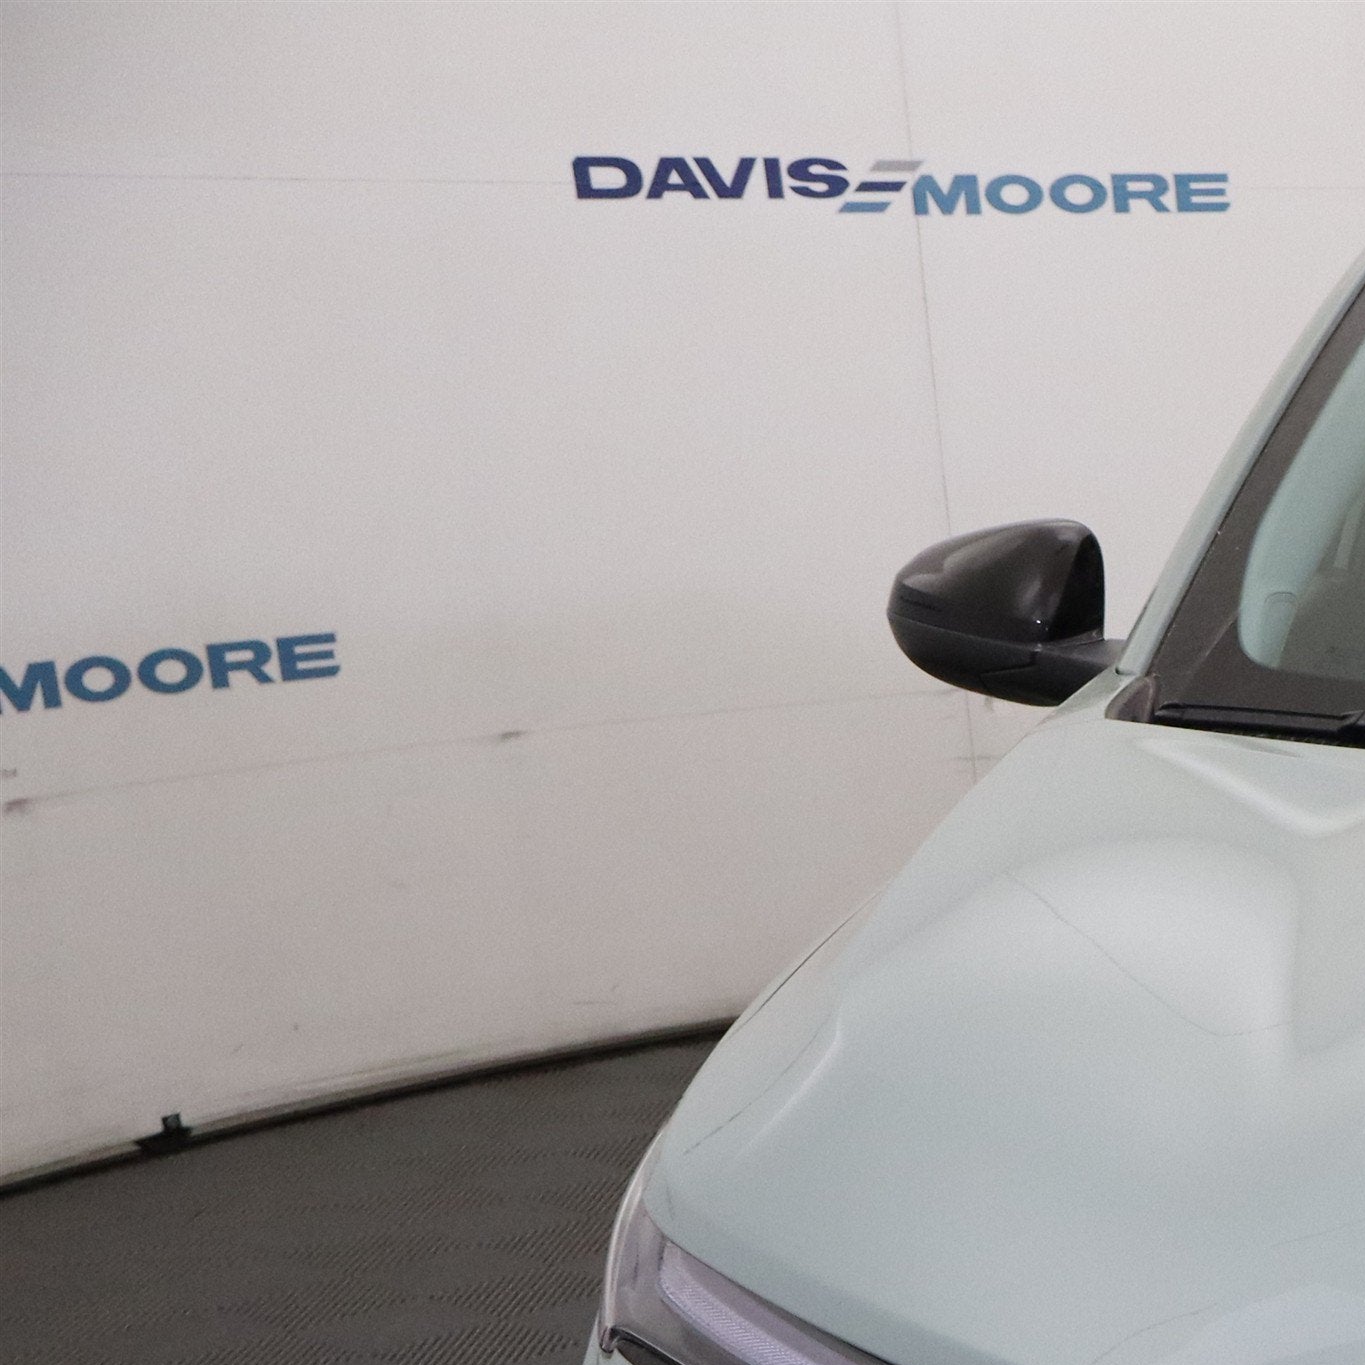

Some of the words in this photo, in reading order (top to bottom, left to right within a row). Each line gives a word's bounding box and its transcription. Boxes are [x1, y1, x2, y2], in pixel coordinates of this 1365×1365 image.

[572, 157, 849, 200] DAVIS
[913, 173, 1231, 216] MOORE
[0, 632, 341, 714] MOORE
